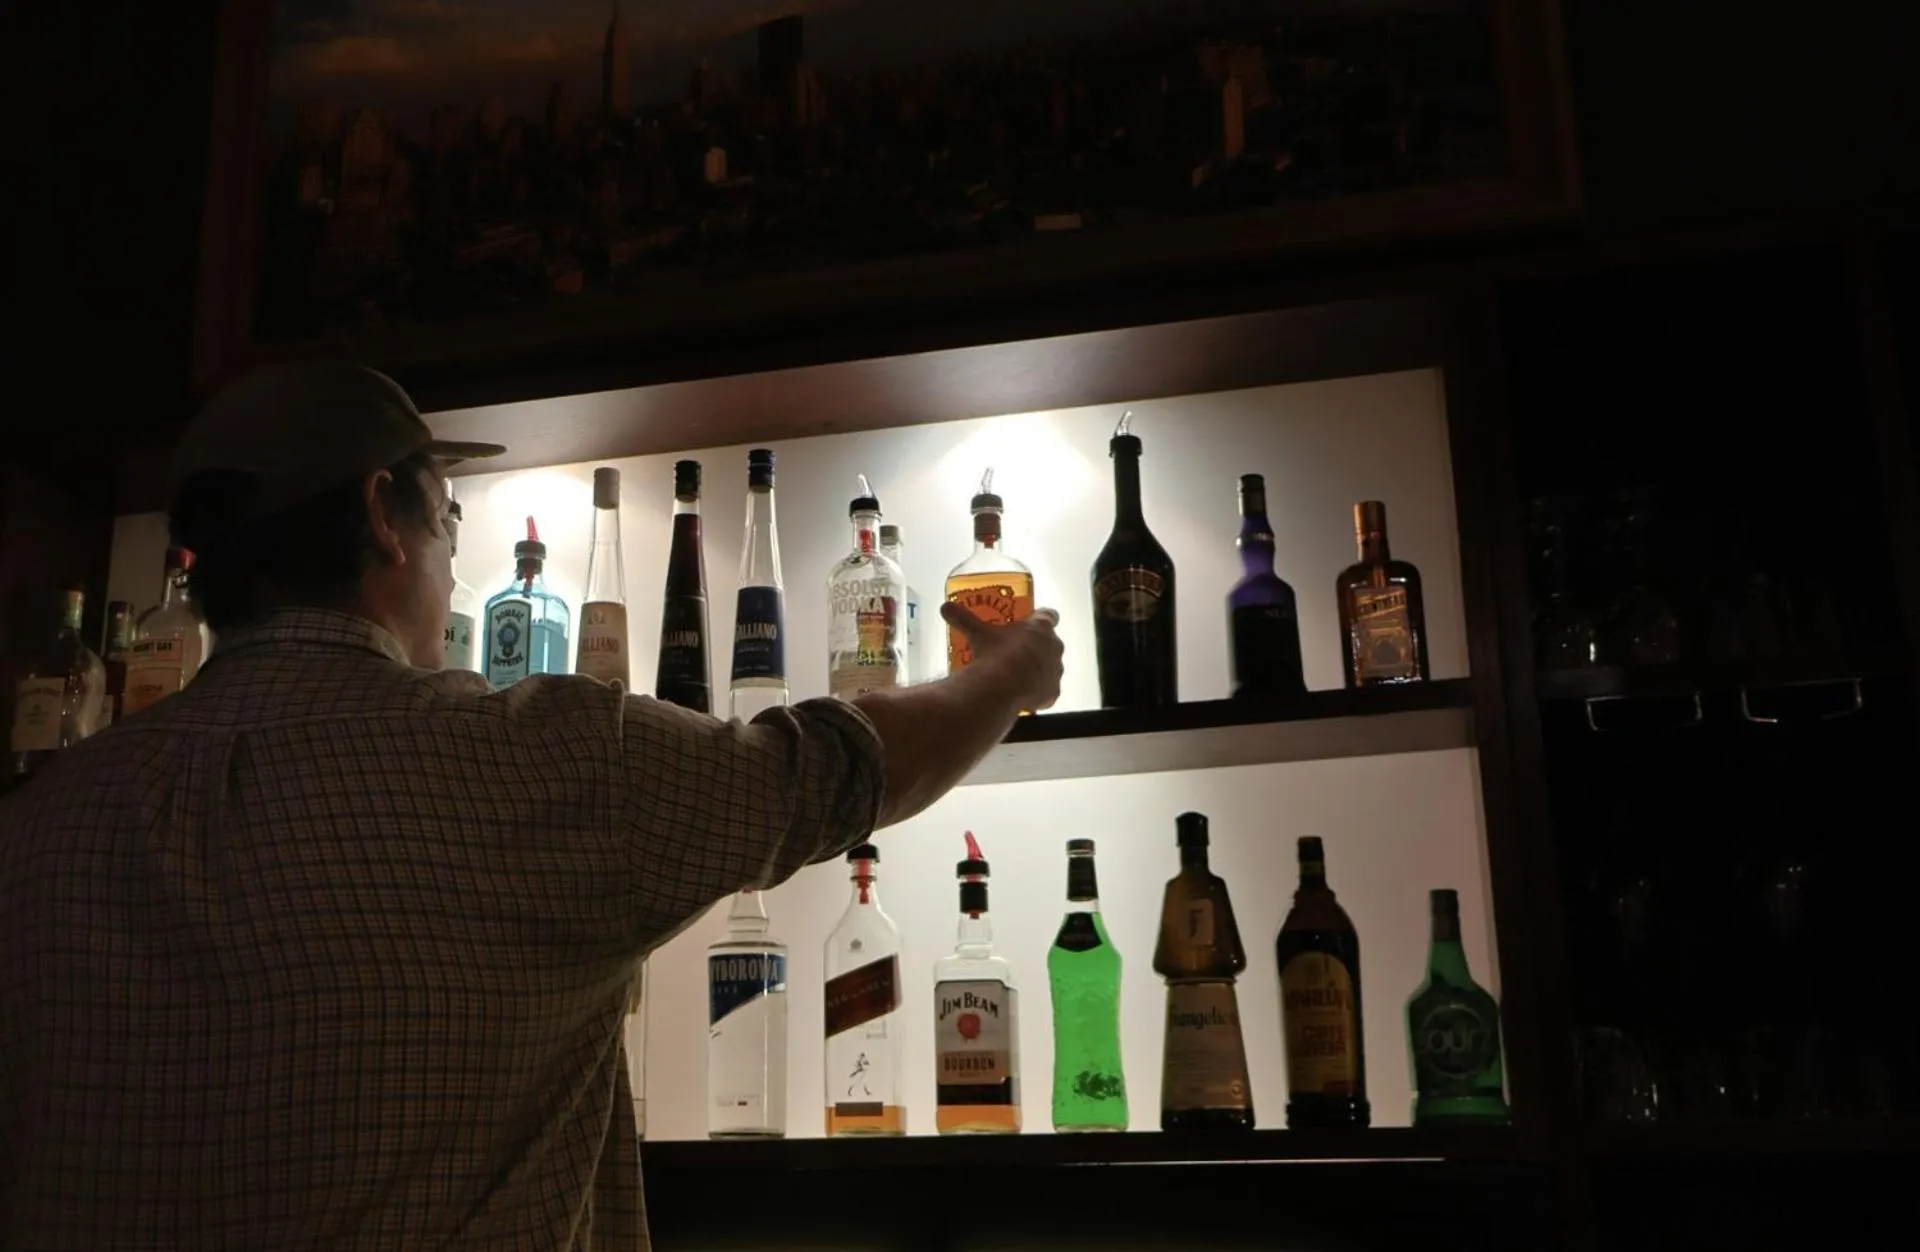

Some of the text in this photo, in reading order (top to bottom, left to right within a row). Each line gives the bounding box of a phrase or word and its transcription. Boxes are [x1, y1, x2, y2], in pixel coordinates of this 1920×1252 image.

[832, 578, 889, 600] BSOLUT
[831, 596, 886, 618] VODKA
[712, 957, 780, 983] YBOROWA
[939, 991, 999, 1021] JIM BEAM
[944, 1056, 996, 1072] BOURBON
